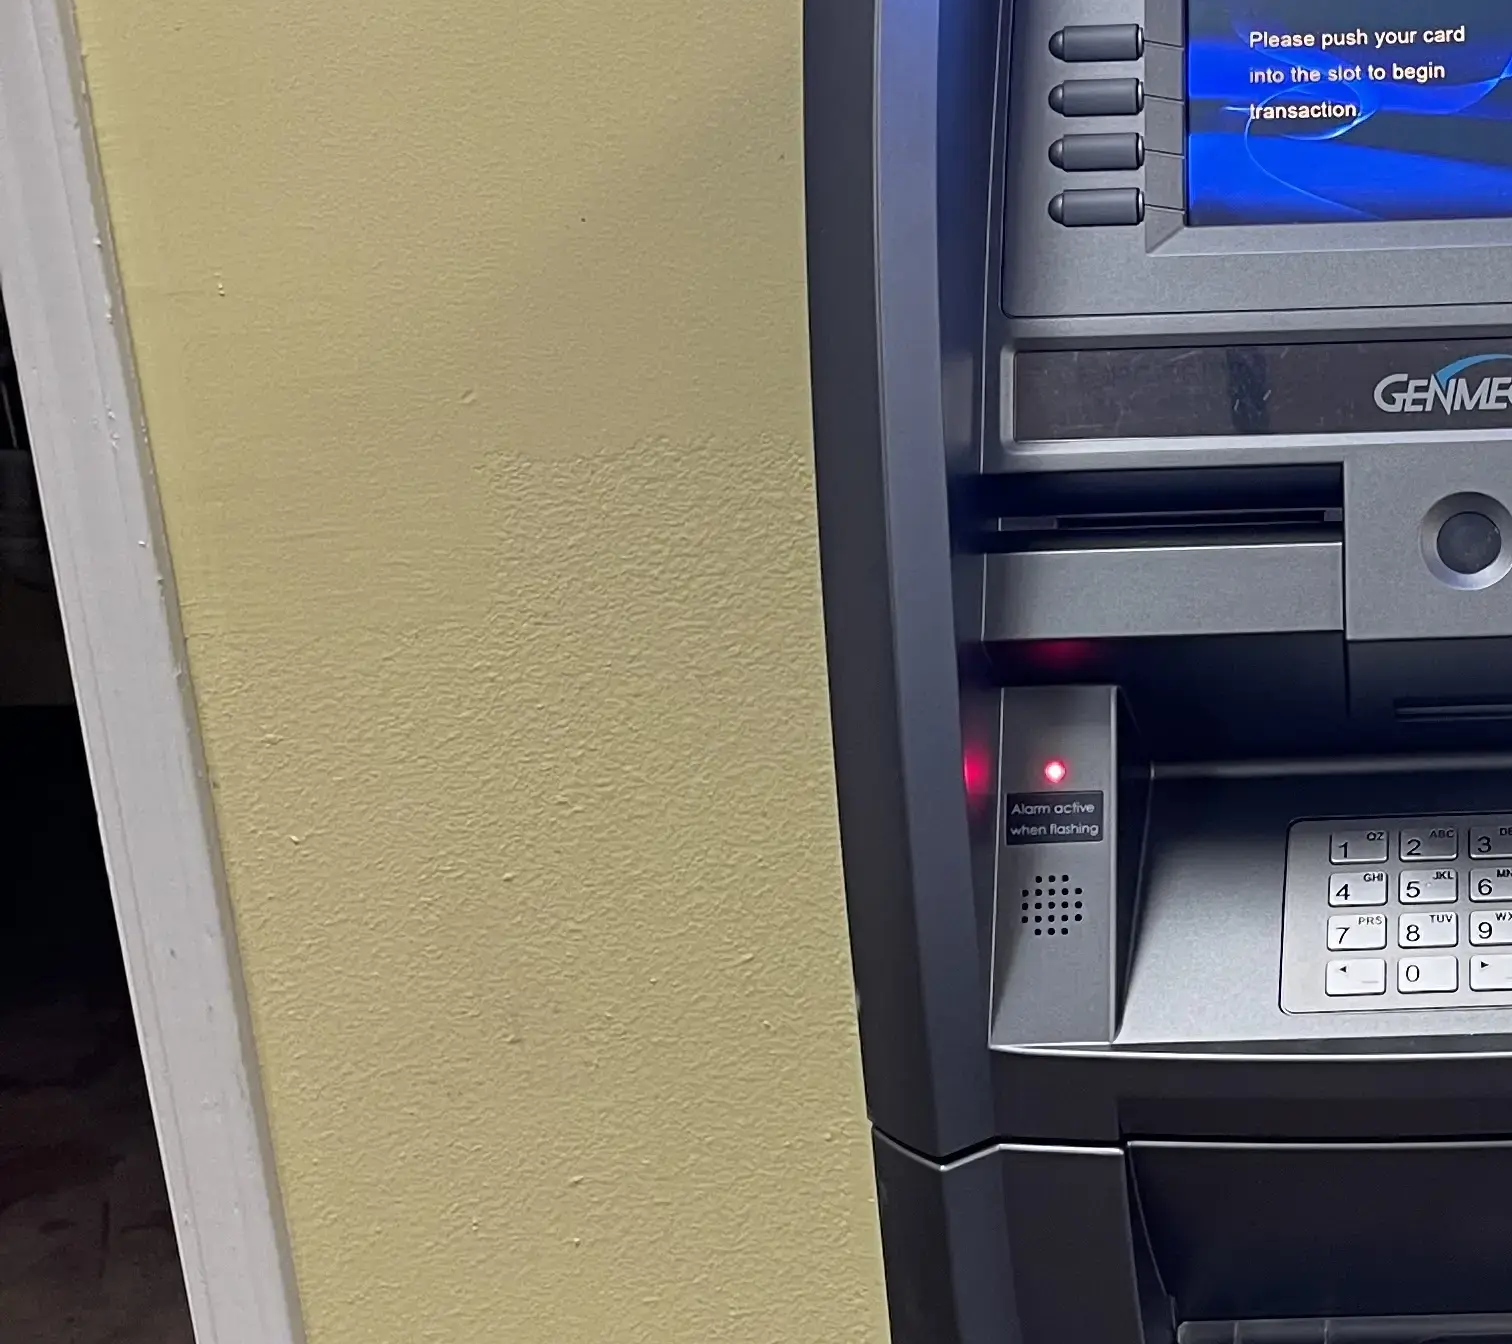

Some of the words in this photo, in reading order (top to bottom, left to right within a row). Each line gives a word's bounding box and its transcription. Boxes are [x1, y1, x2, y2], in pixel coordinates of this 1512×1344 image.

[1250, 31, 1314, 48] Please
[1322, 29, 1368, 49] push
[1375, 30, 1417, 48] your
[1423, 25, 1465, 43] card
[1250, 67, 1284, 83] into
[1291, 66, 1320, 82] the
[1328, 65, 1361, 81] slot
[1368, 65, 1385, 80] to
[1393, 62, 1445, 82] begin
[1250, 101, 1361, 119] transaction.
[1011, 803, 1050, 814] Alarm
[1054, 801, 1094, 814] active
[1011, 824, 1047, 835] when
[1050, 823, 1099, 836] flashing
[1338, 842, 1348, 858] 1
[1406, 839, 1421, 856] 2
[1429, 830, 1454, 838] ABC
[1478, 836, 1492, 852] 3
[1336, 884, 1350, 900] 4
[1363, 873, 1383, 882] GHI
[1406, 881, 1420, 897] 5
[1433, 871, 1454, 880] JKL
[1478, 879, 1492, 895] 6
[1336, 927, 1350, 944] 7
[1358, 916, 1382, 925] PRS
[1406, 925, 1420, 942] 8
[1429, 914, 1453, 923] TUV
[1478, 922, 1492, 939] 9
[1406, 965, 1420, 982] 0
